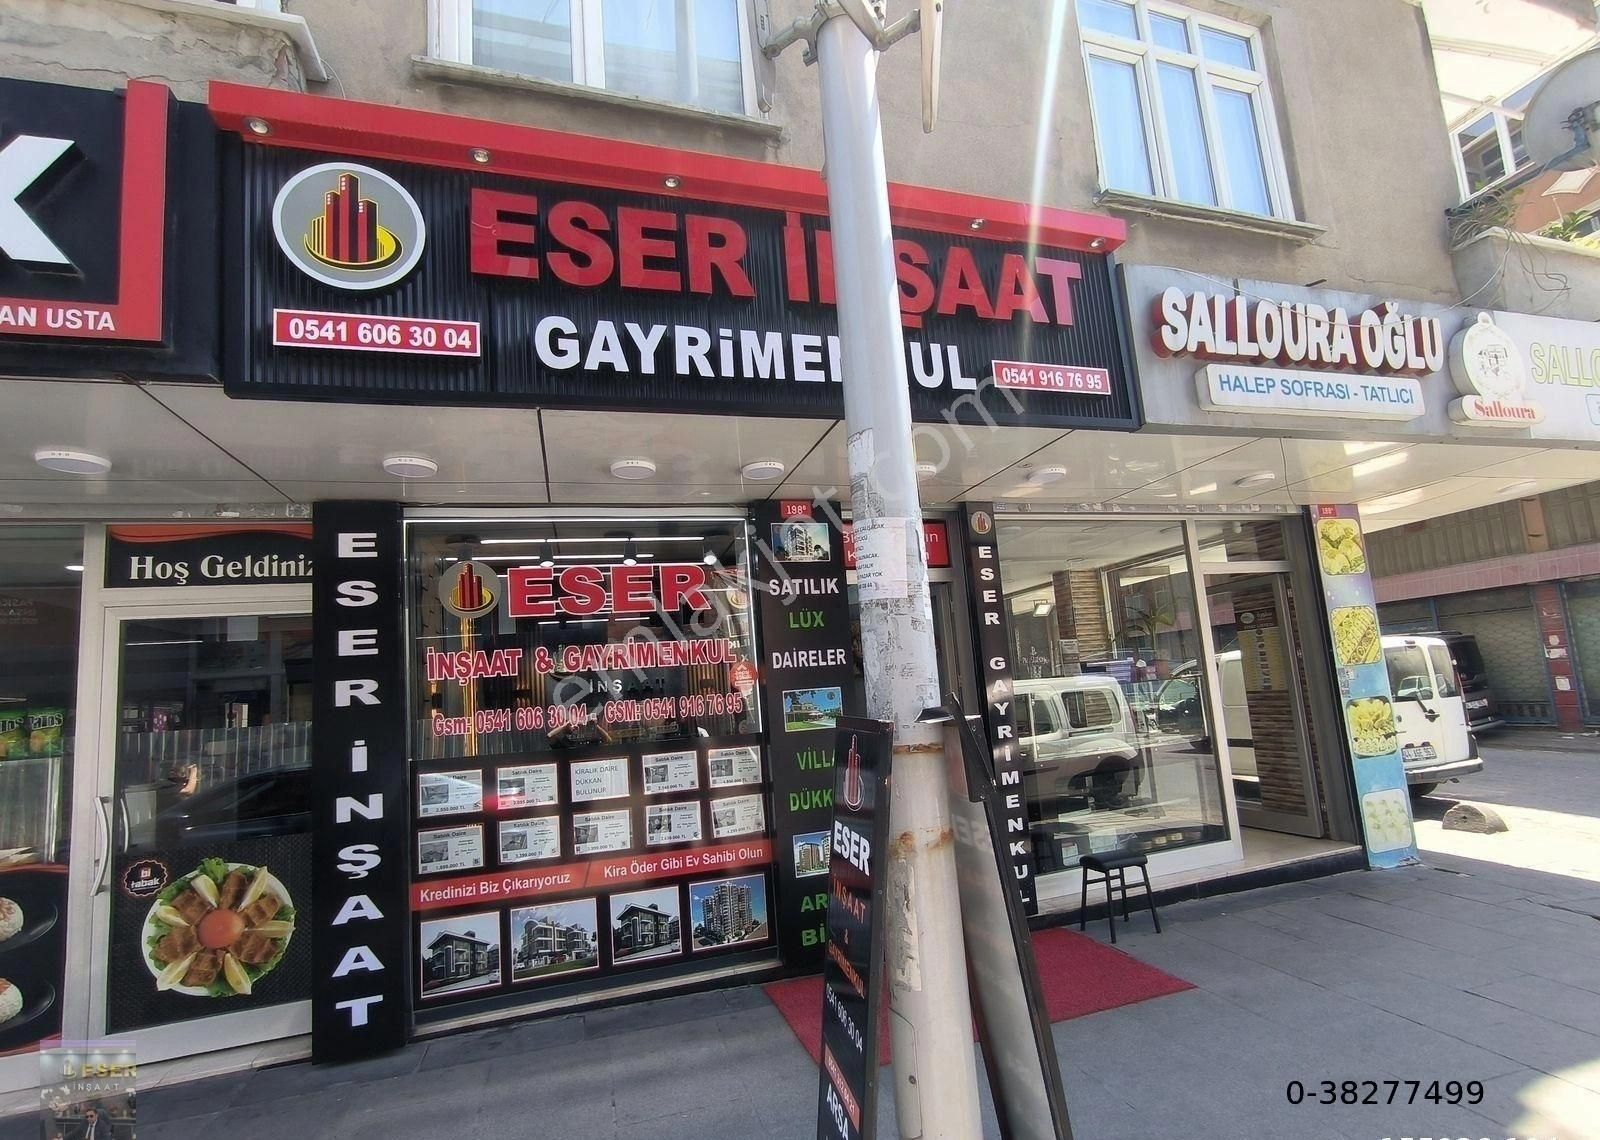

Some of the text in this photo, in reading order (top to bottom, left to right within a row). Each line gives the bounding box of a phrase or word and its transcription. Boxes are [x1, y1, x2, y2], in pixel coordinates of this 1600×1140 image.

[470, 187, 1082, 329] ESER İŞAAT
[46, 308, 116, 332] USTA
[289, 317, 472, 350] 0541 606 30 04
[1160, 285, 1357, 365] SALLOURA
[1360, 301, 1444, 373] OĞLU
[1002, 366, 1102, 390] 0541 916 76 95
[1218, 373, 1276, 395] HALEP
[1280, 376, 1350, 400] SOFRASI
[1359, 384, 1414, 405] TATLICI
[1473, 398, 1537, 420] Salloura
[129, 555, 190, 585] Hoş
[978, 546, 1001, 626] ESER
[507, 564, 712, 619] ESER
[768, 577, 840, 596] SATILIK
[335, 532, 382, 707] ESER
[789, 608, 825, 629] LÜX
[426, 645, 523, 686] İNŞAAT
[534, 646, 554, 675] &
[562, 637, 737, 674] GAYRİMENKUL
[771, 647, 847, 669] DAİRELER
[432, 713, 471, 736] Gsm:
[474, 709, 512, 734] 0541
[515, 708, 544, 731] 606
[547, 704, 568, 728] 30
[568, 702, 588, 727] 04
[604, 700, 641, 724] GSM:
[643, 696, 676, 721] 0541
[679, 695, 703, 719] 916
[705, 693, 723, 716] 76
[725, 692, 744, 715] 95
[604, 847, 763, 879] Kira Öder Gibi Ev Sahibi Olun
[833, 820, 870, 877] ESER
[420, 872, 571, 902] Kredinizi Biz Çıkarıyoruz
